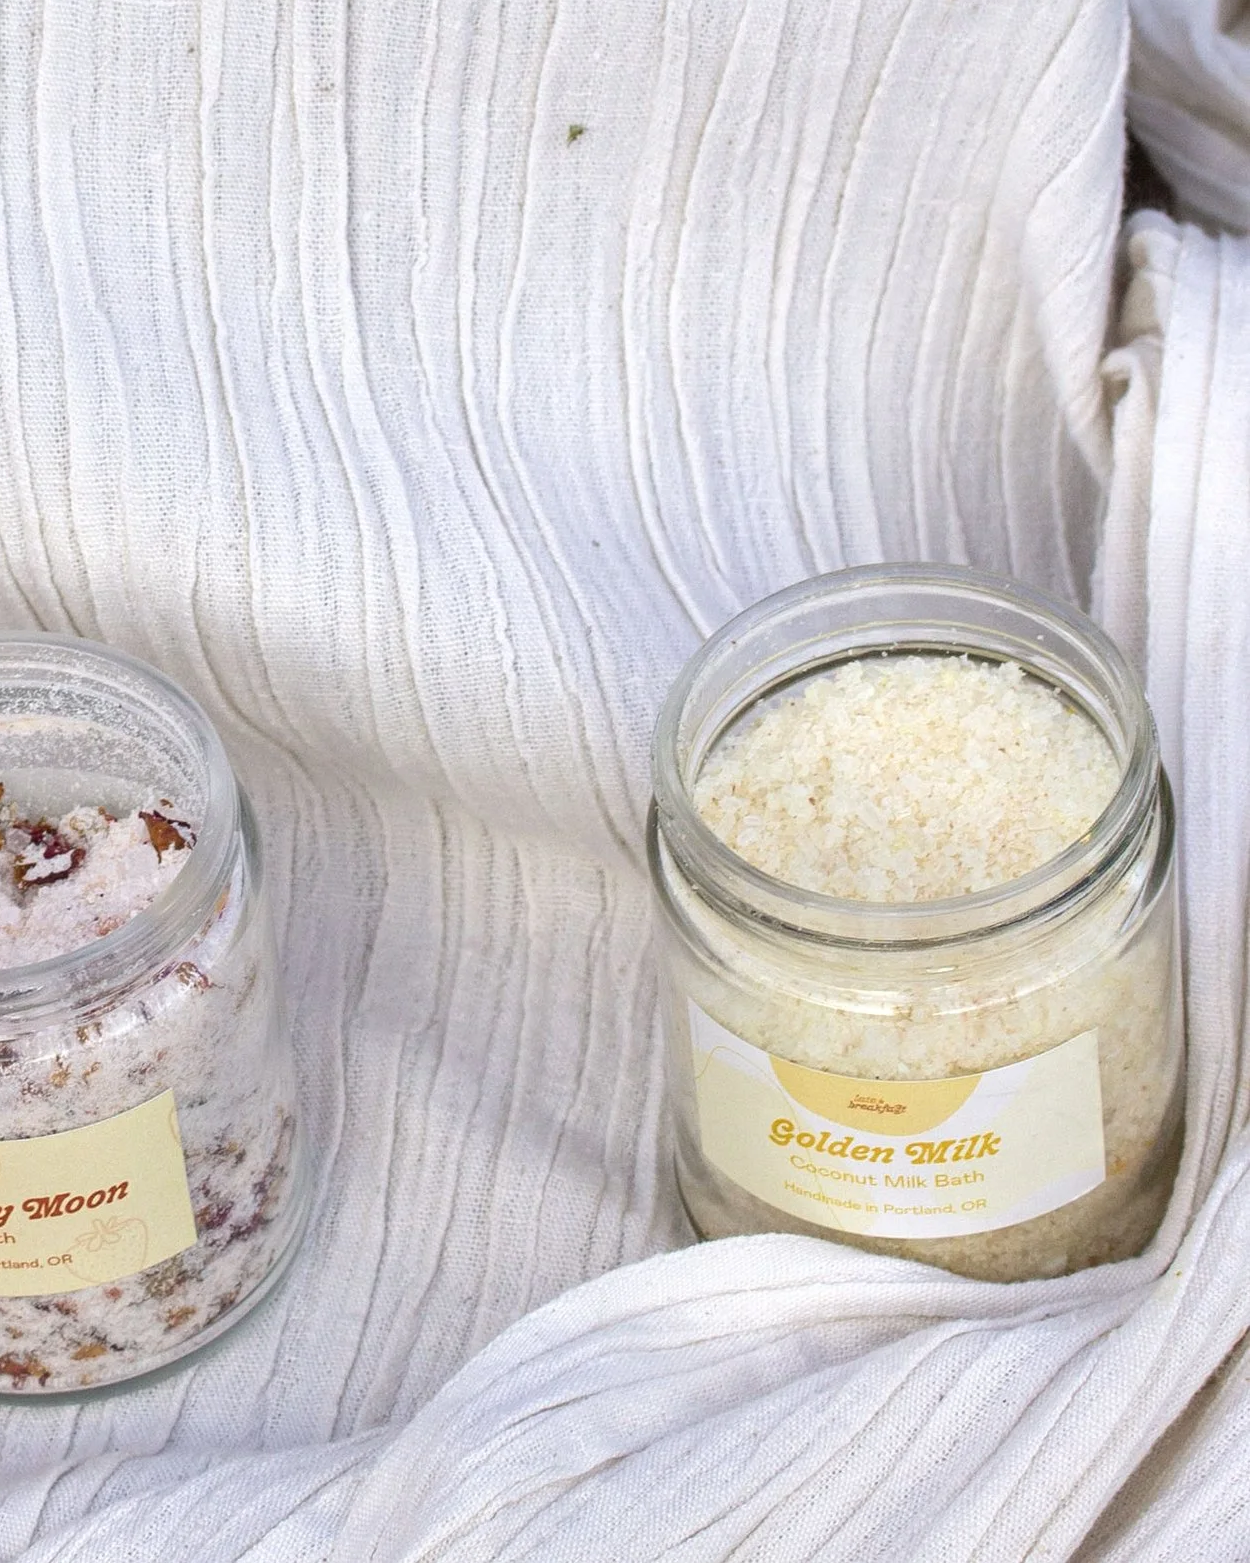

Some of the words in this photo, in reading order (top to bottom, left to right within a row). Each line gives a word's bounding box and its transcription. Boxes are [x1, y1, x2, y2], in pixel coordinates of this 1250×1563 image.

[769, 1117, 894, 1164] Golden
[906, 1132, 1001, 1166] Milk
[789, 1154, 877, 1187] Coconut
[884, 1172, 927, 1188] Milk
[935, 1170, 985, 1188] Bath
[22, 1180, 130, 1221] Moon
[784, 1179, 861, 1211] Handmade
[865, 1201, 879, 1214] in
[884, 1201, 955, 1216] Portland,
[961, 1198, 987, 1210] OR
[47, 1253, 73, 1266] OR
